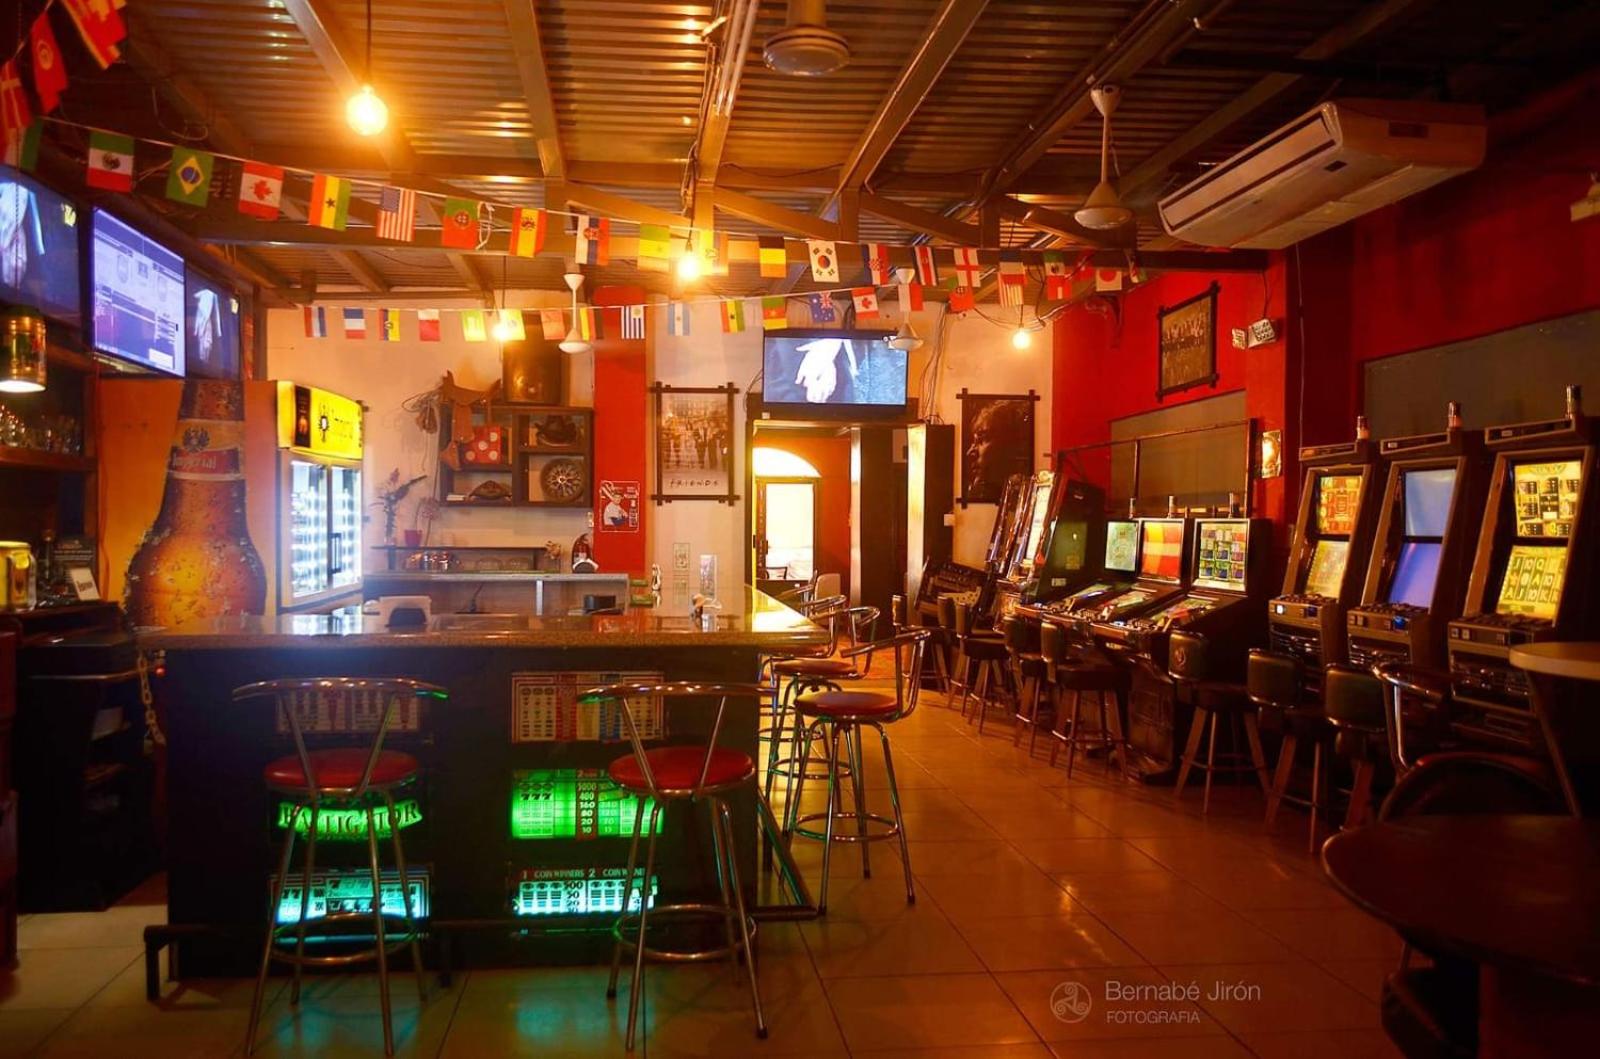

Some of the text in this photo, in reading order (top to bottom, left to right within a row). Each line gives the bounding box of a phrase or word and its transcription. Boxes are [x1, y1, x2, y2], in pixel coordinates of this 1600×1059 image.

[670, 479, 719, 489] FRIENDS
[580, 801, 596, 809] 160
[581, 809, 593, 817] 80
[581, 817, 593, 825] 20
[534, 870, 552, 879] COIN
[588, 868, 595, 878] 2
